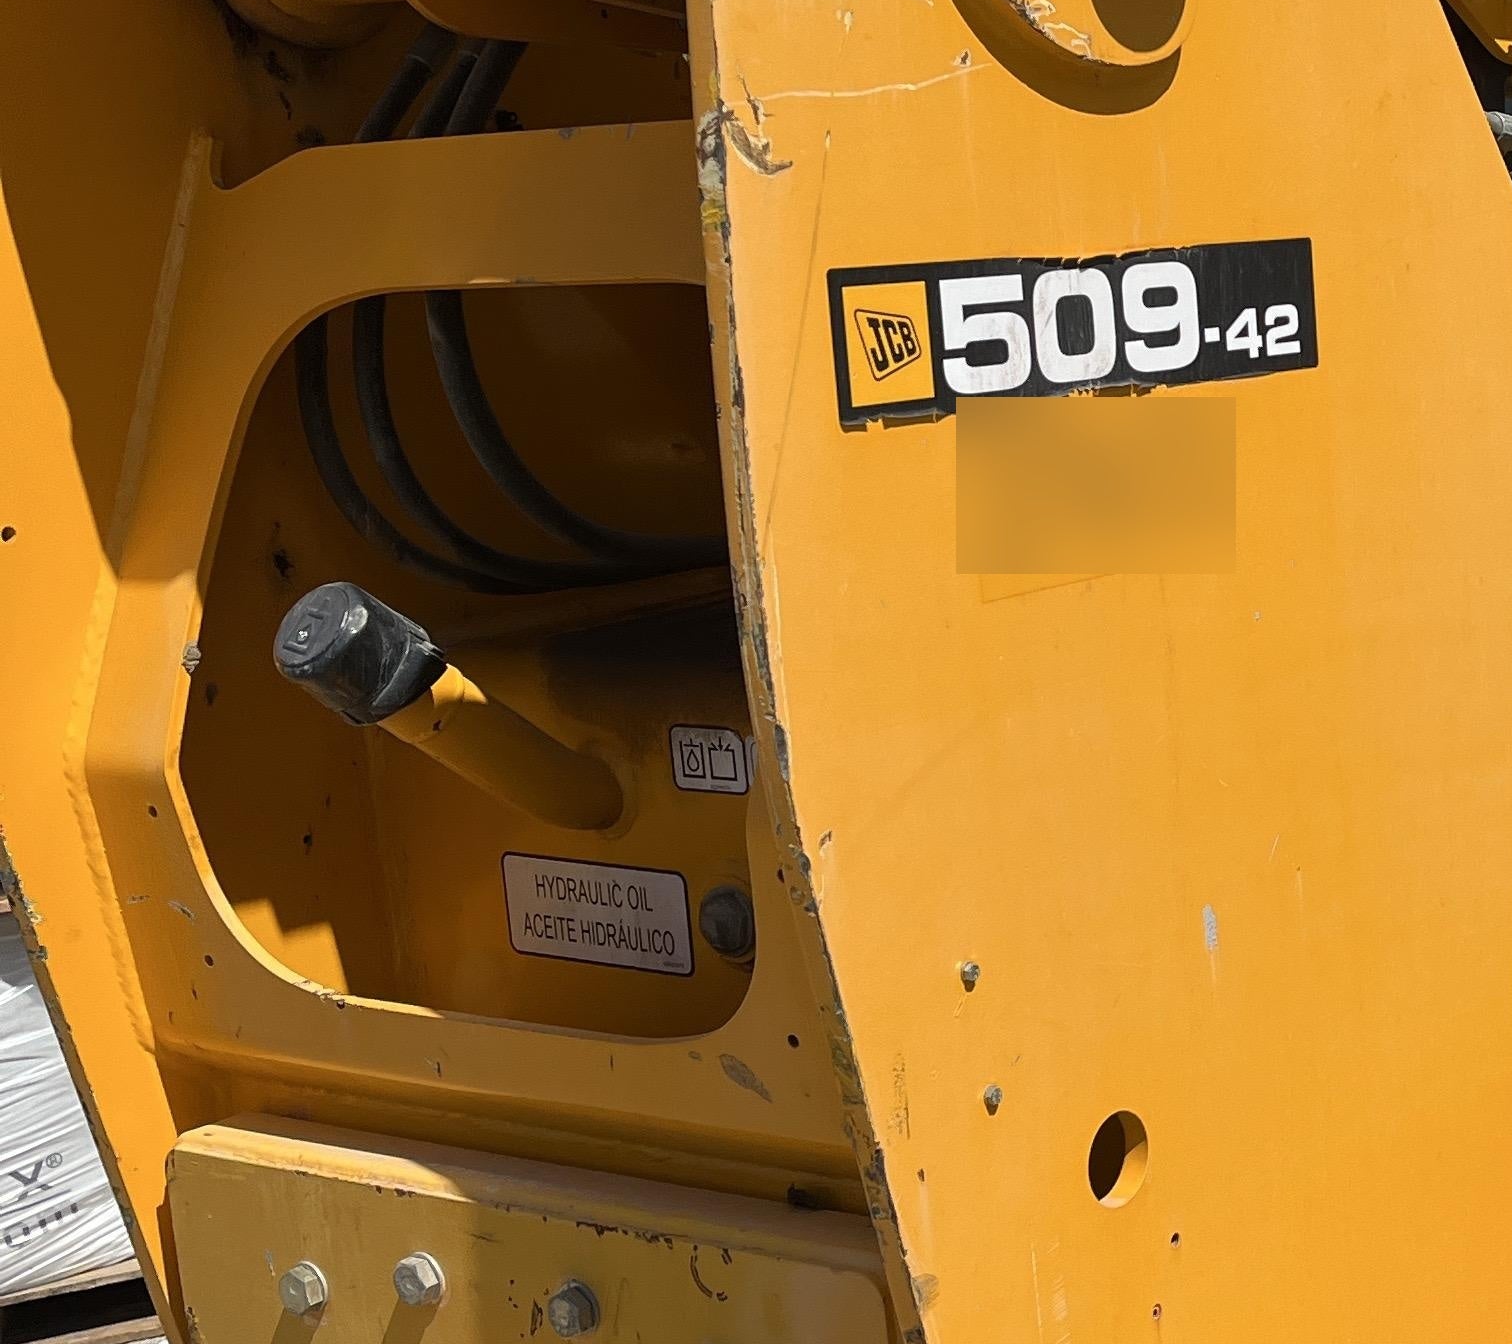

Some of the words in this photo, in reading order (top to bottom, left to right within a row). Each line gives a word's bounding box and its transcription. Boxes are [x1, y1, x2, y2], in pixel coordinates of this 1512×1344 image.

[864, 314, 920, 370] JCB
[938, 260, 1302, 394] 509-42
[534, 873, 623, 908] HYDRAULIC
[627, 885, 654, 912] OIL
[524, 912, 577, 943] ACEITE
[580, 919, 675, 956] HIDRÁULICO
